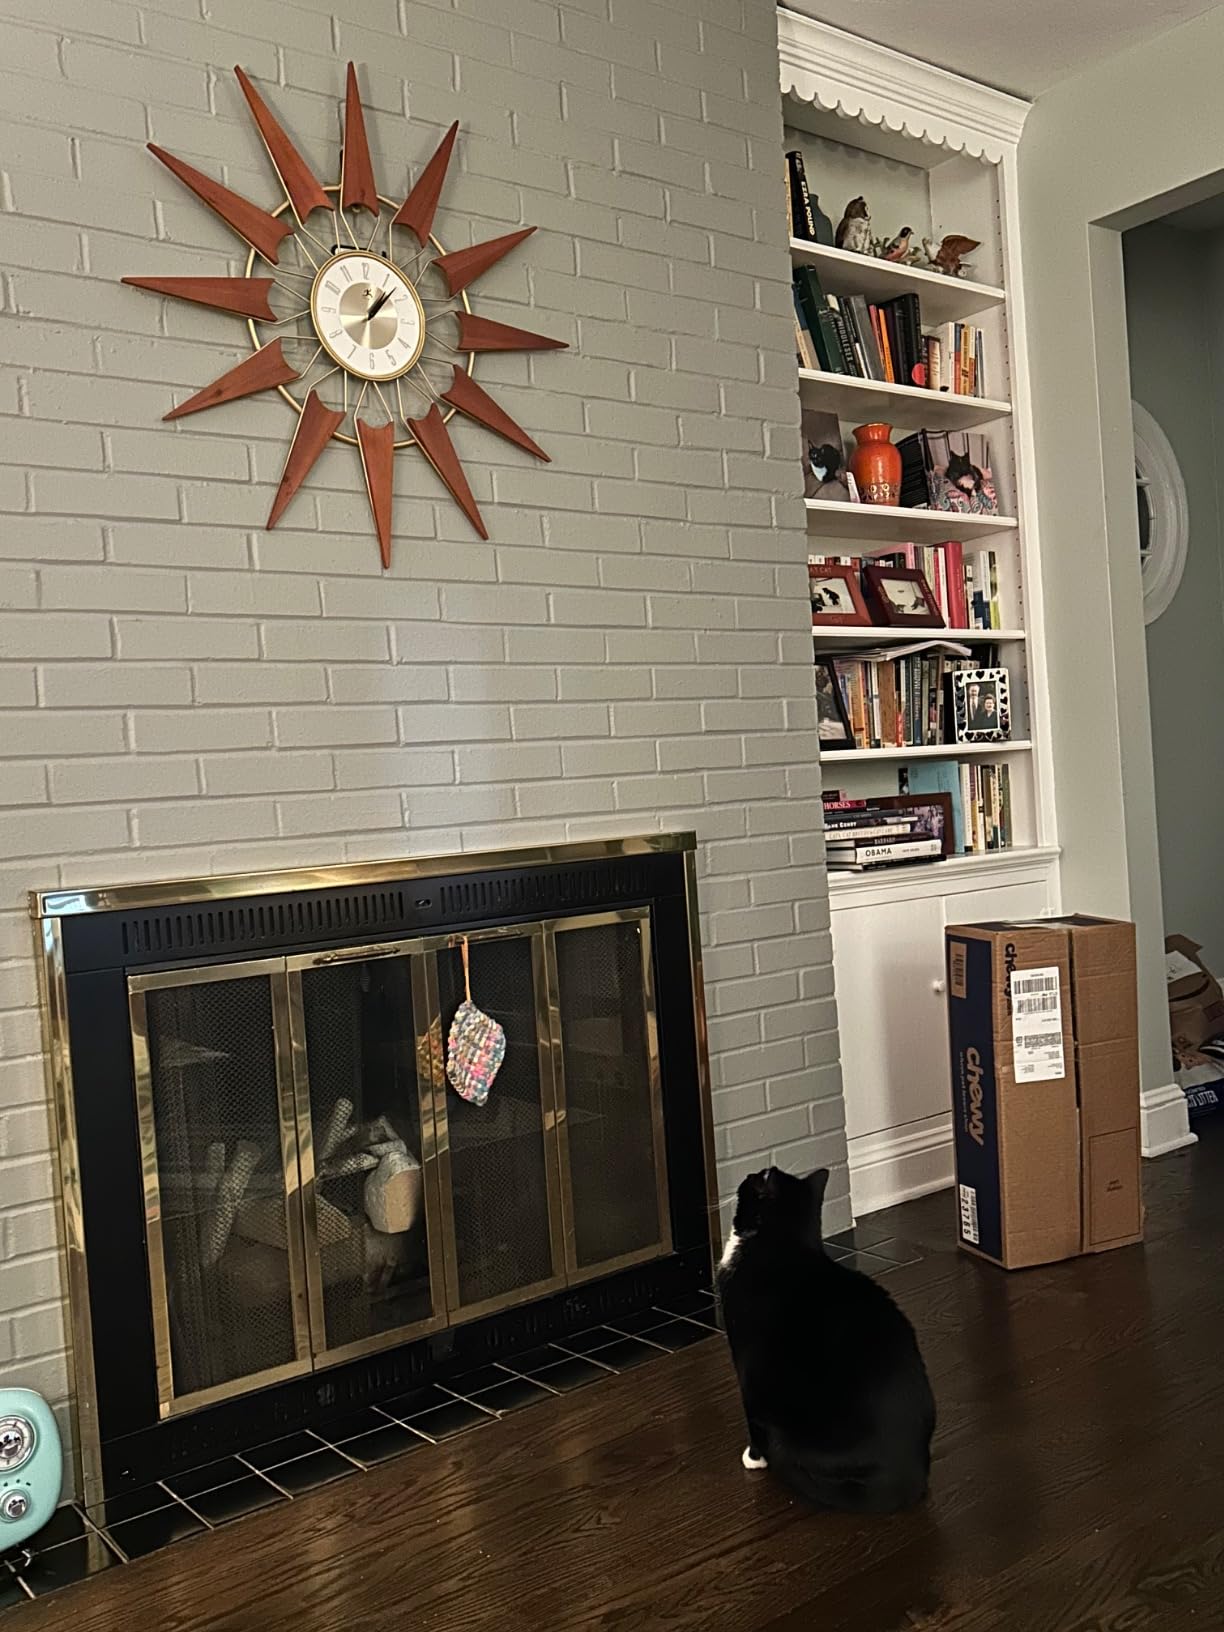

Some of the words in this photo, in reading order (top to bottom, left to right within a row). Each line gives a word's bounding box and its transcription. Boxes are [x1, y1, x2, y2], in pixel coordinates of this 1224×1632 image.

[800, 181, 809, 205] EZRA
[805, 206, 816, 236] POUND
[339, 265, 353, 283] 11
[361, 262, 370, 280] 12
[324, 280, 341, 295] 10
[382, 273, 390, 288] 1
[394, 294, 408, 302] 2
[321, 306, 337, 314] 9
[400, 318, 415, 326] 3
[329, 328, 343, 339] 8
[837, 318, 854, 362] MIDDLESEX
[397, 337, 411, 350] 4
[347, 344, 357, 360] 7
[385, 349, 397, 367] 5
[369, 352, 375, 370] 6
[823, 800, 851, 810] HORSES
[865, 847, 892, 857] OBAMA
[966, 1046, 984, 1146] chewy
